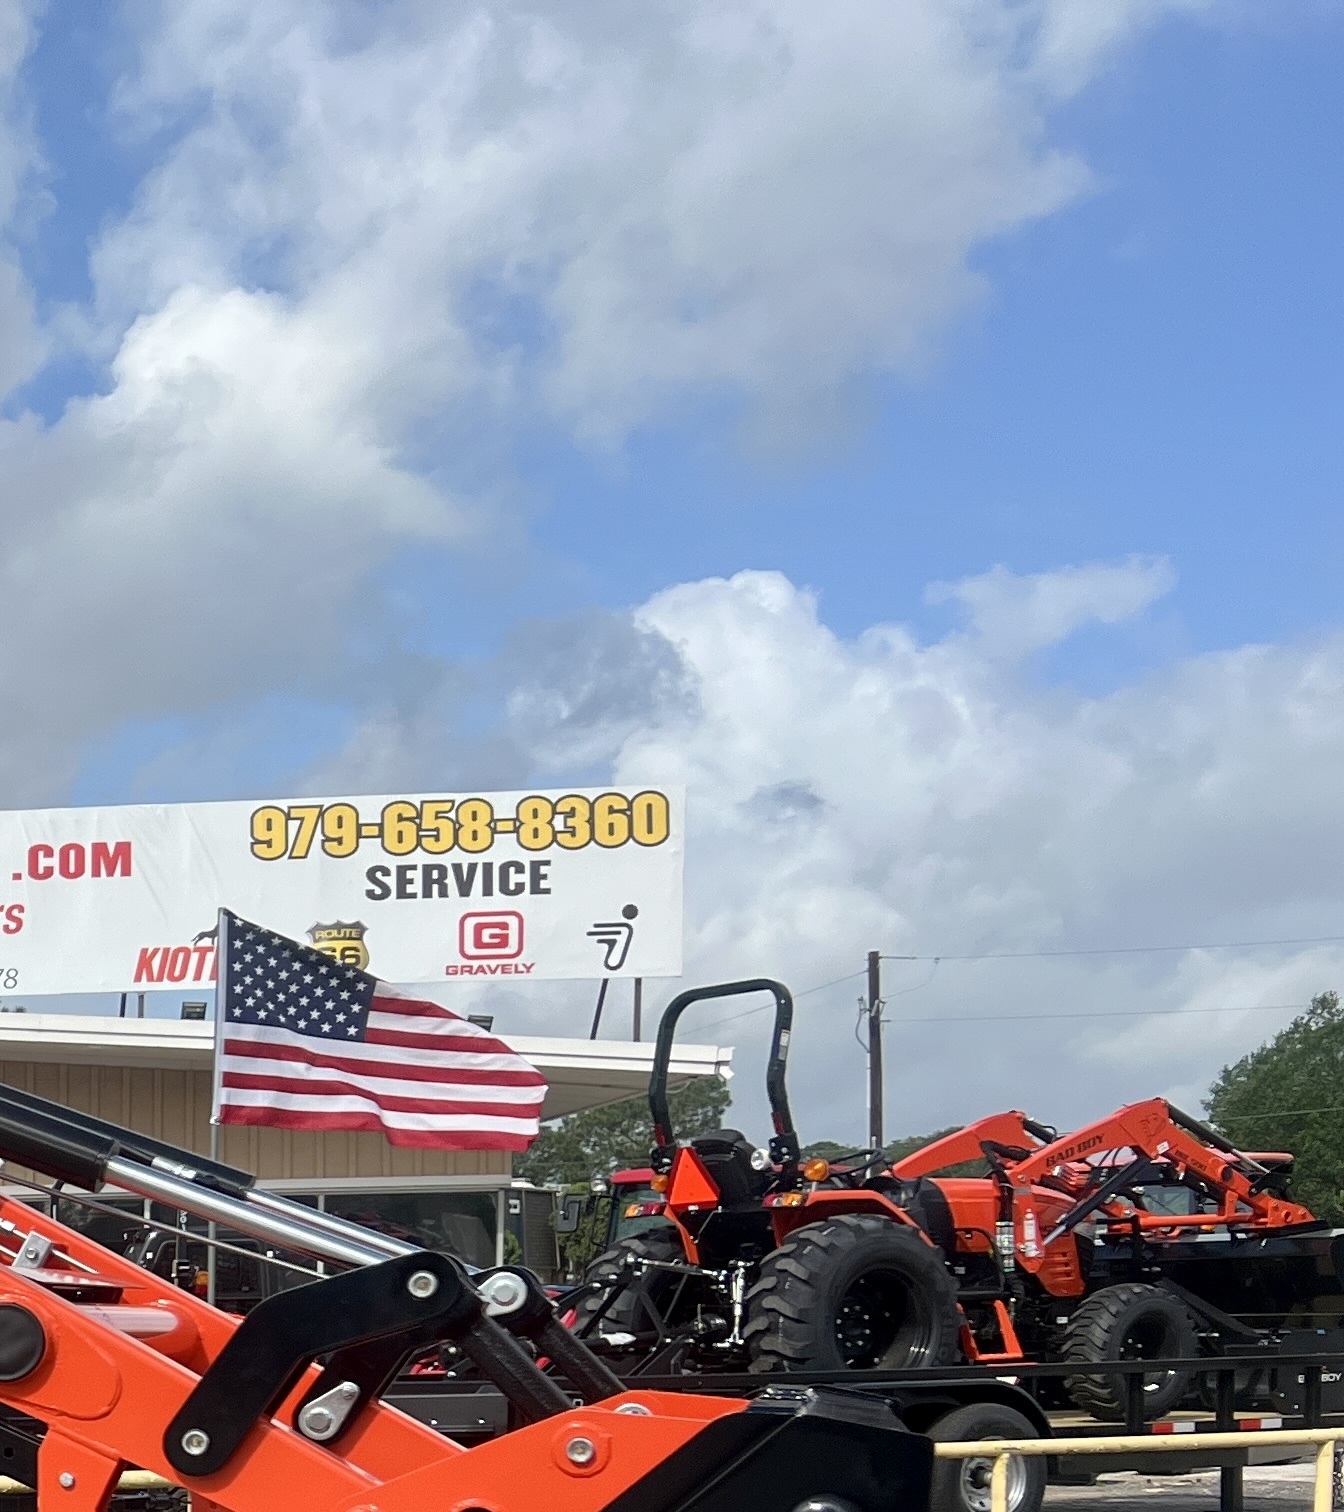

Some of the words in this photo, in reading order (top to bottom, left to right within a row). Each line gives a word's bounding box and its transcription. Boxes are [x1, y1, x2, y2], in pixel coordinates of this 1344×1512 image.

[251, 790, 670, 861] 979-658-8360
[13, 841, 133, 881] .COM
[365, 860, 552, 901] SERVICE
[315, 928, 360, 939] ROUTE
[445, 963, 536, 976] GRAVELY
